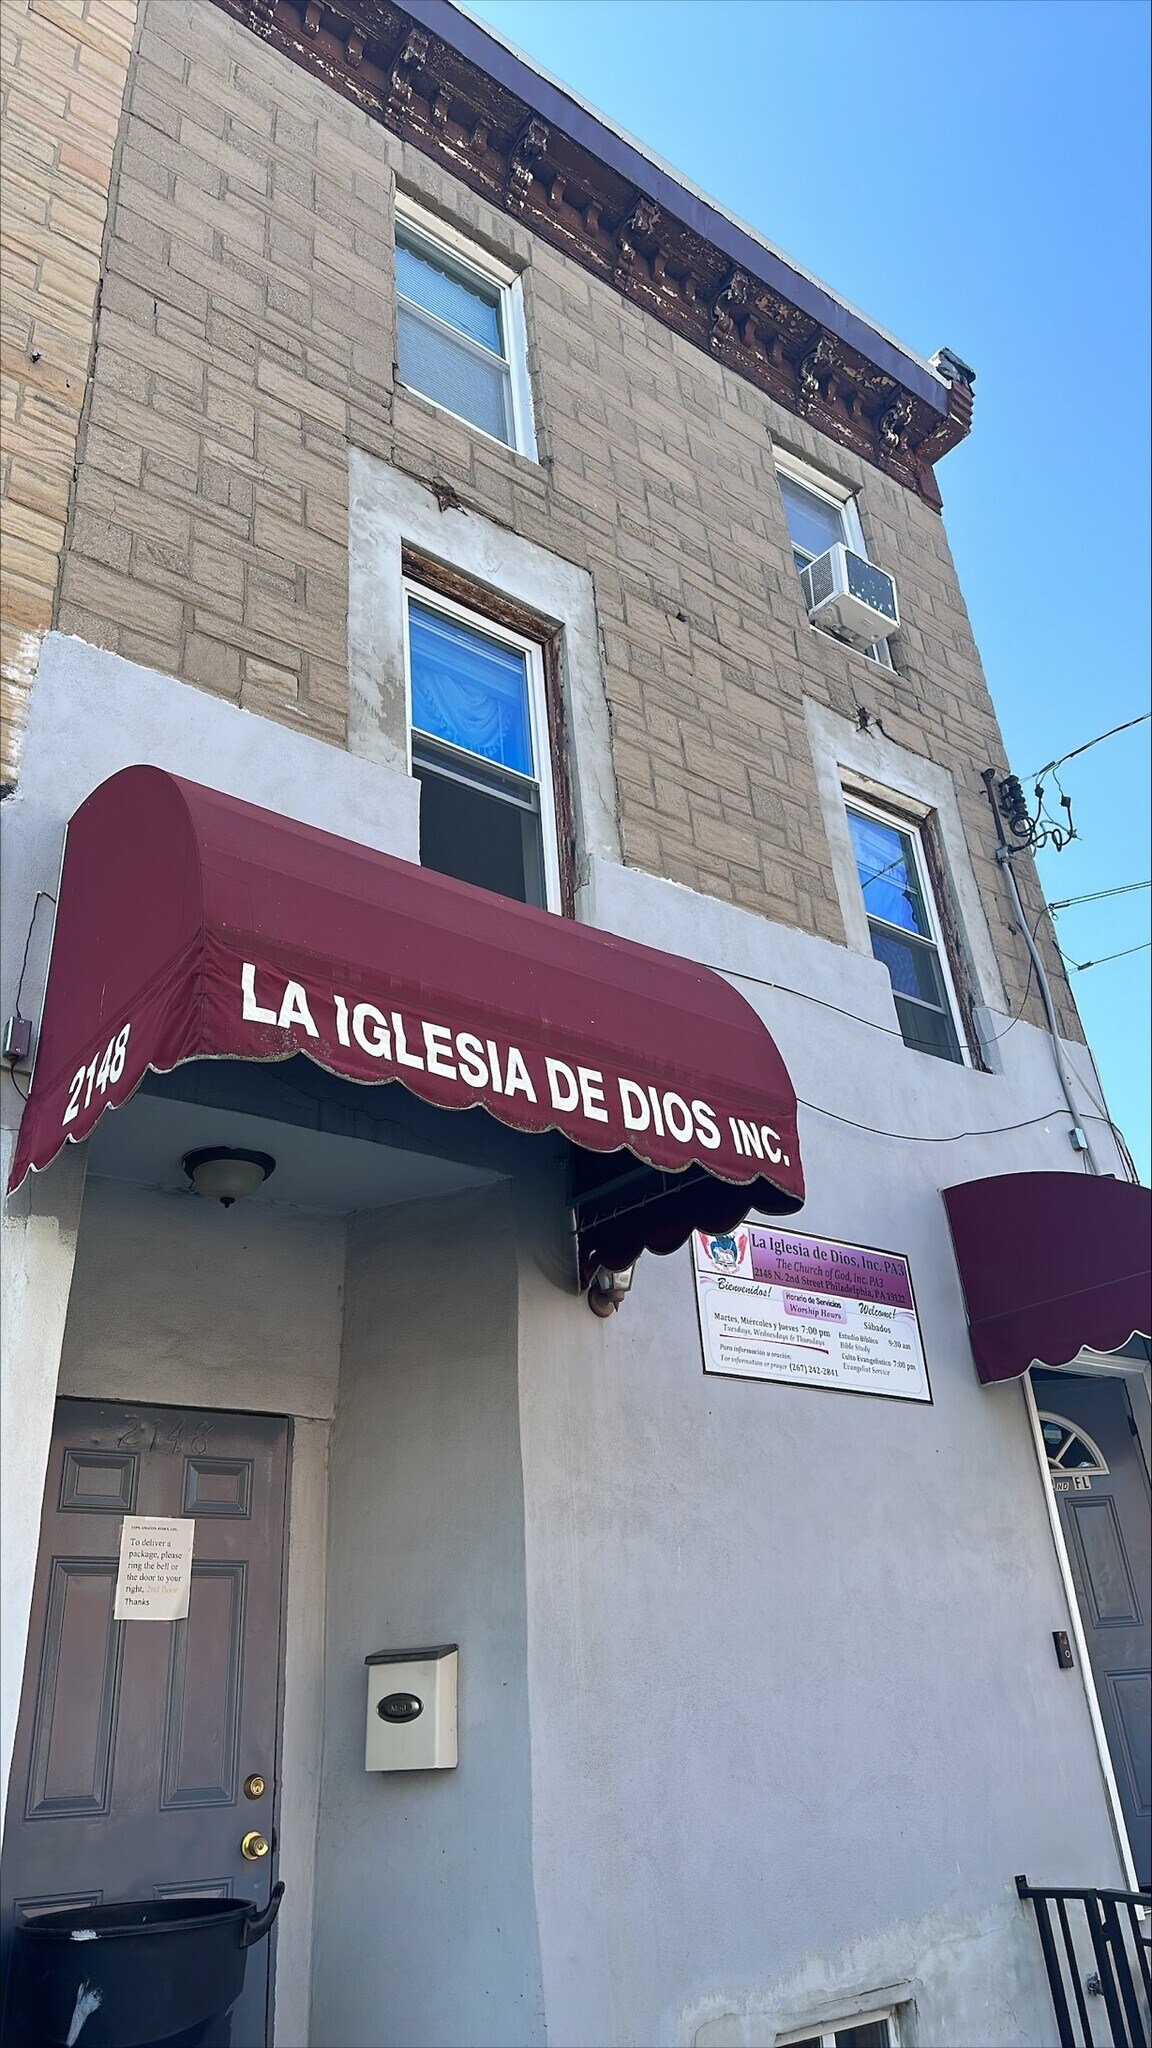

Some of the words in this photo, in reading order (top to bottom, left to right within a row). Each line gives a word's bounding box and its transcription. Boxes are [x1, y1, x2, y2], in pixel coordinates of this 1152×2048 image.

[242, 962, 319, 1038] LA
[333, 995, 537, 1103] IGLESIA
[544, 1056, 608, 1123] DE
[618, 1077, 721, 1149] DIOS
[729, 1116, 790, 1167] INC.
[62, 1023, 130, 1126] 2148
[751, 1233, 766, 1248] La
[770, 1237, 810, 1255] Iglesia
[813, 1246, 828, 1260] de
[830, 1250, 860, 1269] Dios,
[862, 1256, 883, 1271] Inc.
[884, 1260, 905, 1277] PA3
[776, 1258, 791, 1270] The
[793, 1262, 823, 1275] Church
[825, 1267, 835, 1280] of
[834, 1269, 852, 1283] God,
[853, 1274, 868, 1285] Inc.
[870, 1276, 884, 1287] PA3
[717, 1277, 773, 1298] Bienvenidos!
[754, 1267, 772, 1279] 2148
[773, 1271, 783, 1280] N.
[785, 1273, 800, 1284] 2nd
[801, 1276, 823, 1288] Street
[825, 1279, 874, 1299] Philadelphia,
[874, 1289, 887, 1300] PA
[887, 1291, 906, 1304] 19122
[786, 1292, 807, 1304] Horario
[808, 1296, 816, 1304] de
[816, 1298, 842, 1309] Servicios
[789, 1303, 820, 1317] Worship
[820, 1308, 842, 1319] Hours
[858, 1302, 896, 1319] Welcome!
[714, 1312, 740, 1324] Martes,
[740, 1316, 772, 1329] Miércoles
[778, 1322, 799, 1333] Jueves
[801, 1325, 818, 1336] 7:00
[819, 1330, 831, 1338] pm
[864, 1321, 891, 1334] Sábados
[723, 1324, 753, 1337] Tuesdays,
[753, 1328, 789, 1341] Wednesdays
[790, 1333, 796, 1341] &
[796, 1335, 825, 1346] Thursdays
[839, 1331, 860, 1342] Estudio
[840, 1341, 854, 1351] Bible
[855, 1344, 871, 1354] Study
[888, 1339, 902, 1348] 9:30
[731, 1356, 763, 1366] information
[789, 1362, 808, 1374] (267)
[842, 1352, 857, 1362] Culto
[893, 1360, 906, 1370] 7:00
[907, 1363, 917, 1371] pm
[871, 1367, 890, 1376] Service
[118, 1415, 213, 1455] 2148
[1074, 1476, 1090, 1489] FL
[130, 1538, 140, 1546] To
[141, 1539, 166, 1547] deliver
[128, 1550, 159, 1560] package,
[160, 1551, 182, 1560] please
[128, 1561, 142, 1571] ring
[143, 1561, 155, 1570] the
[156, 1562, 170, 1570] bell
[126, 1572, 138, 1581] the
[139, 1573, 156, 1581] door
[157, 1574, 164, 1582] to
[125, 1584, 145, 1594] right,
[146, 1585, 160, 1593] 2nd
[161, 1585, 178, 1594] floor
[125, 1597, 150, 1606] Thanks
